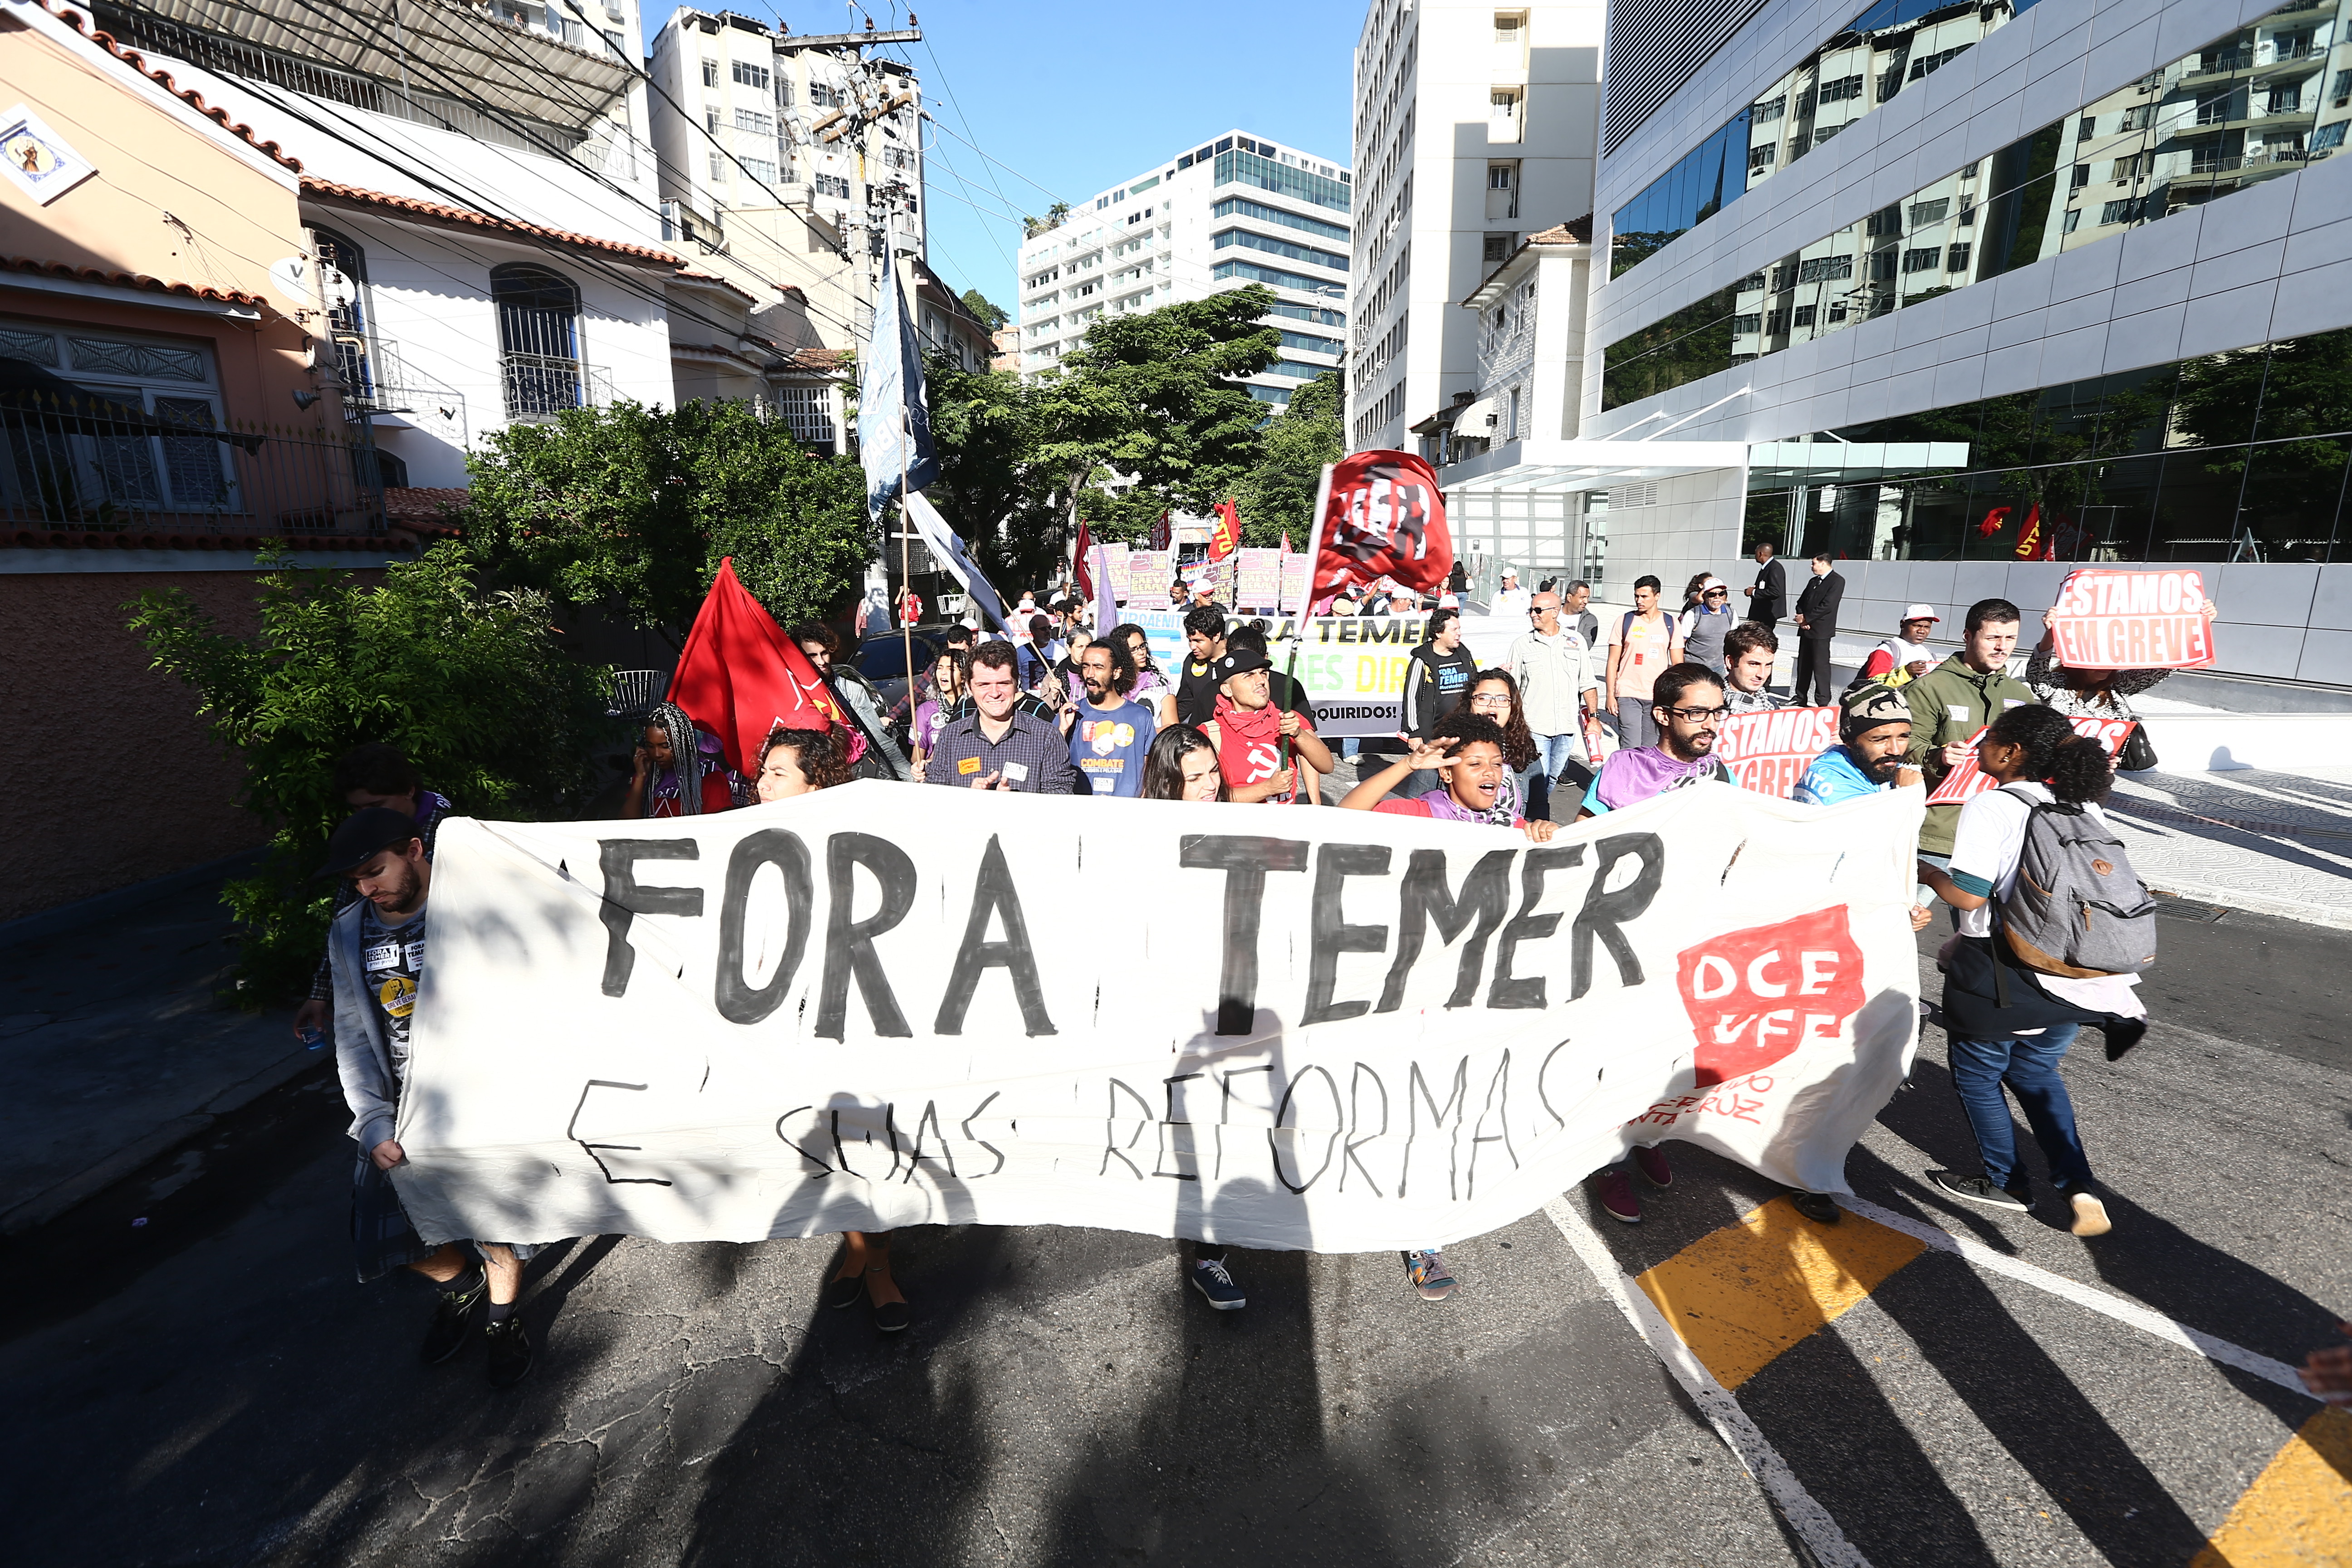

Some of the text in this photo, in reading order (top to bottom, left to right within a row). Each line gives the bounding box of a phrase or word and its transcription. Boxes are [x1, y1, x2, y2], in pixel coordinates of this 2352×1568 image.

[1152, 555, 1166, 563] 30
[1093, 568, 1129, 578] GEVE
[1214, 586, 1231, 594] EVE
[2057, 572, 2204, 616] ESTAMOS
[1225, 618, 1303, 642] ORA
[2059, 617, 2204, 663] EM GREVE
[1438, 667, 1457, 676] FORA
[1440, 672, 1468, 685] TEMER
[1312, 706, 1396, 721] QUIRIDOS!
[1080, 758, 1125, 768] COMBATE
[1800, 770, 1833, 797] NTO
[732, 796, 751, 805] REFO
[597, 827, 1665, 1044] FORA TEMER
[368, 953, 390, 961] TEMER
[1693, 949, 1839, 1000] DCE
[387, 999, 402, 1009] GREVE
[567, 1079, 672, 1186] E
[776, 1091, 1005, 1184] SUAS
